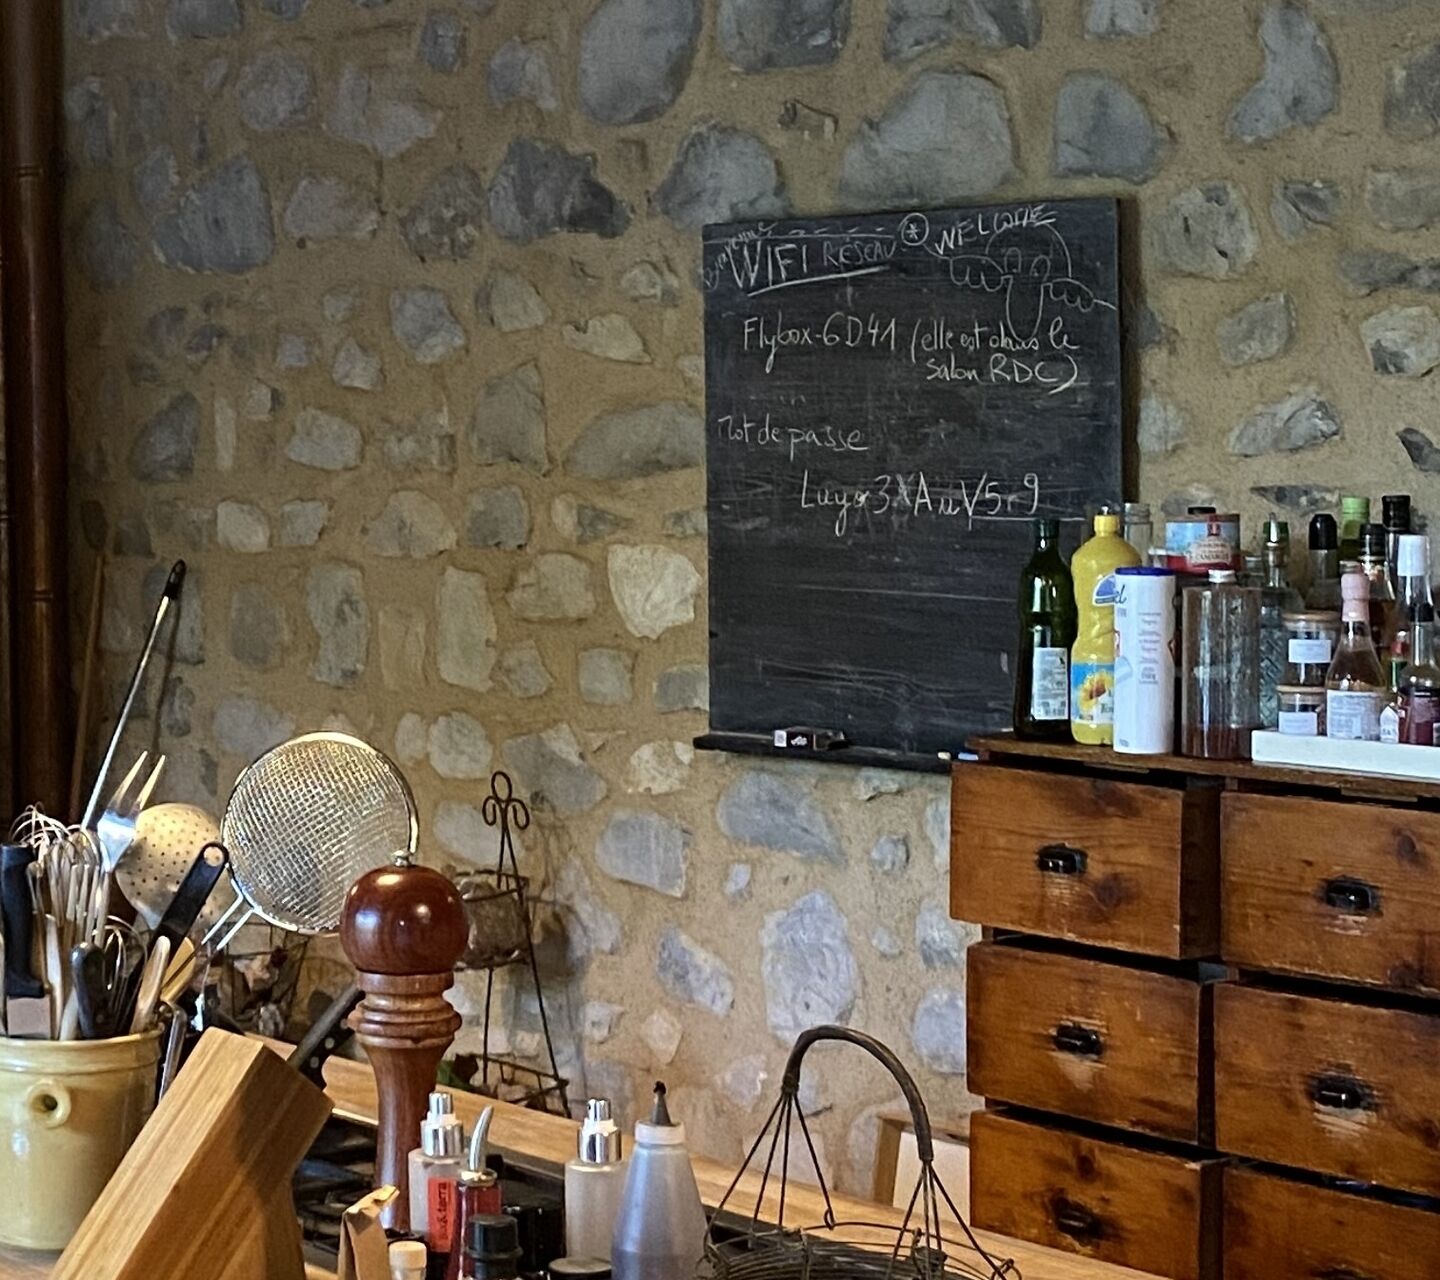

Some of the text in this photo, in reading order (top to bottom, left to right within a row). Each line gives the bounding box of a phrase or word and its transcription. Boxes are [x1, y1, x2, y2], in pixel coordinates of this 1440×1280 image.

[724, 239, 809, 289] WIFI
[1048, 316, 1081, 350] le
[785, 425, 871, 462] passe
